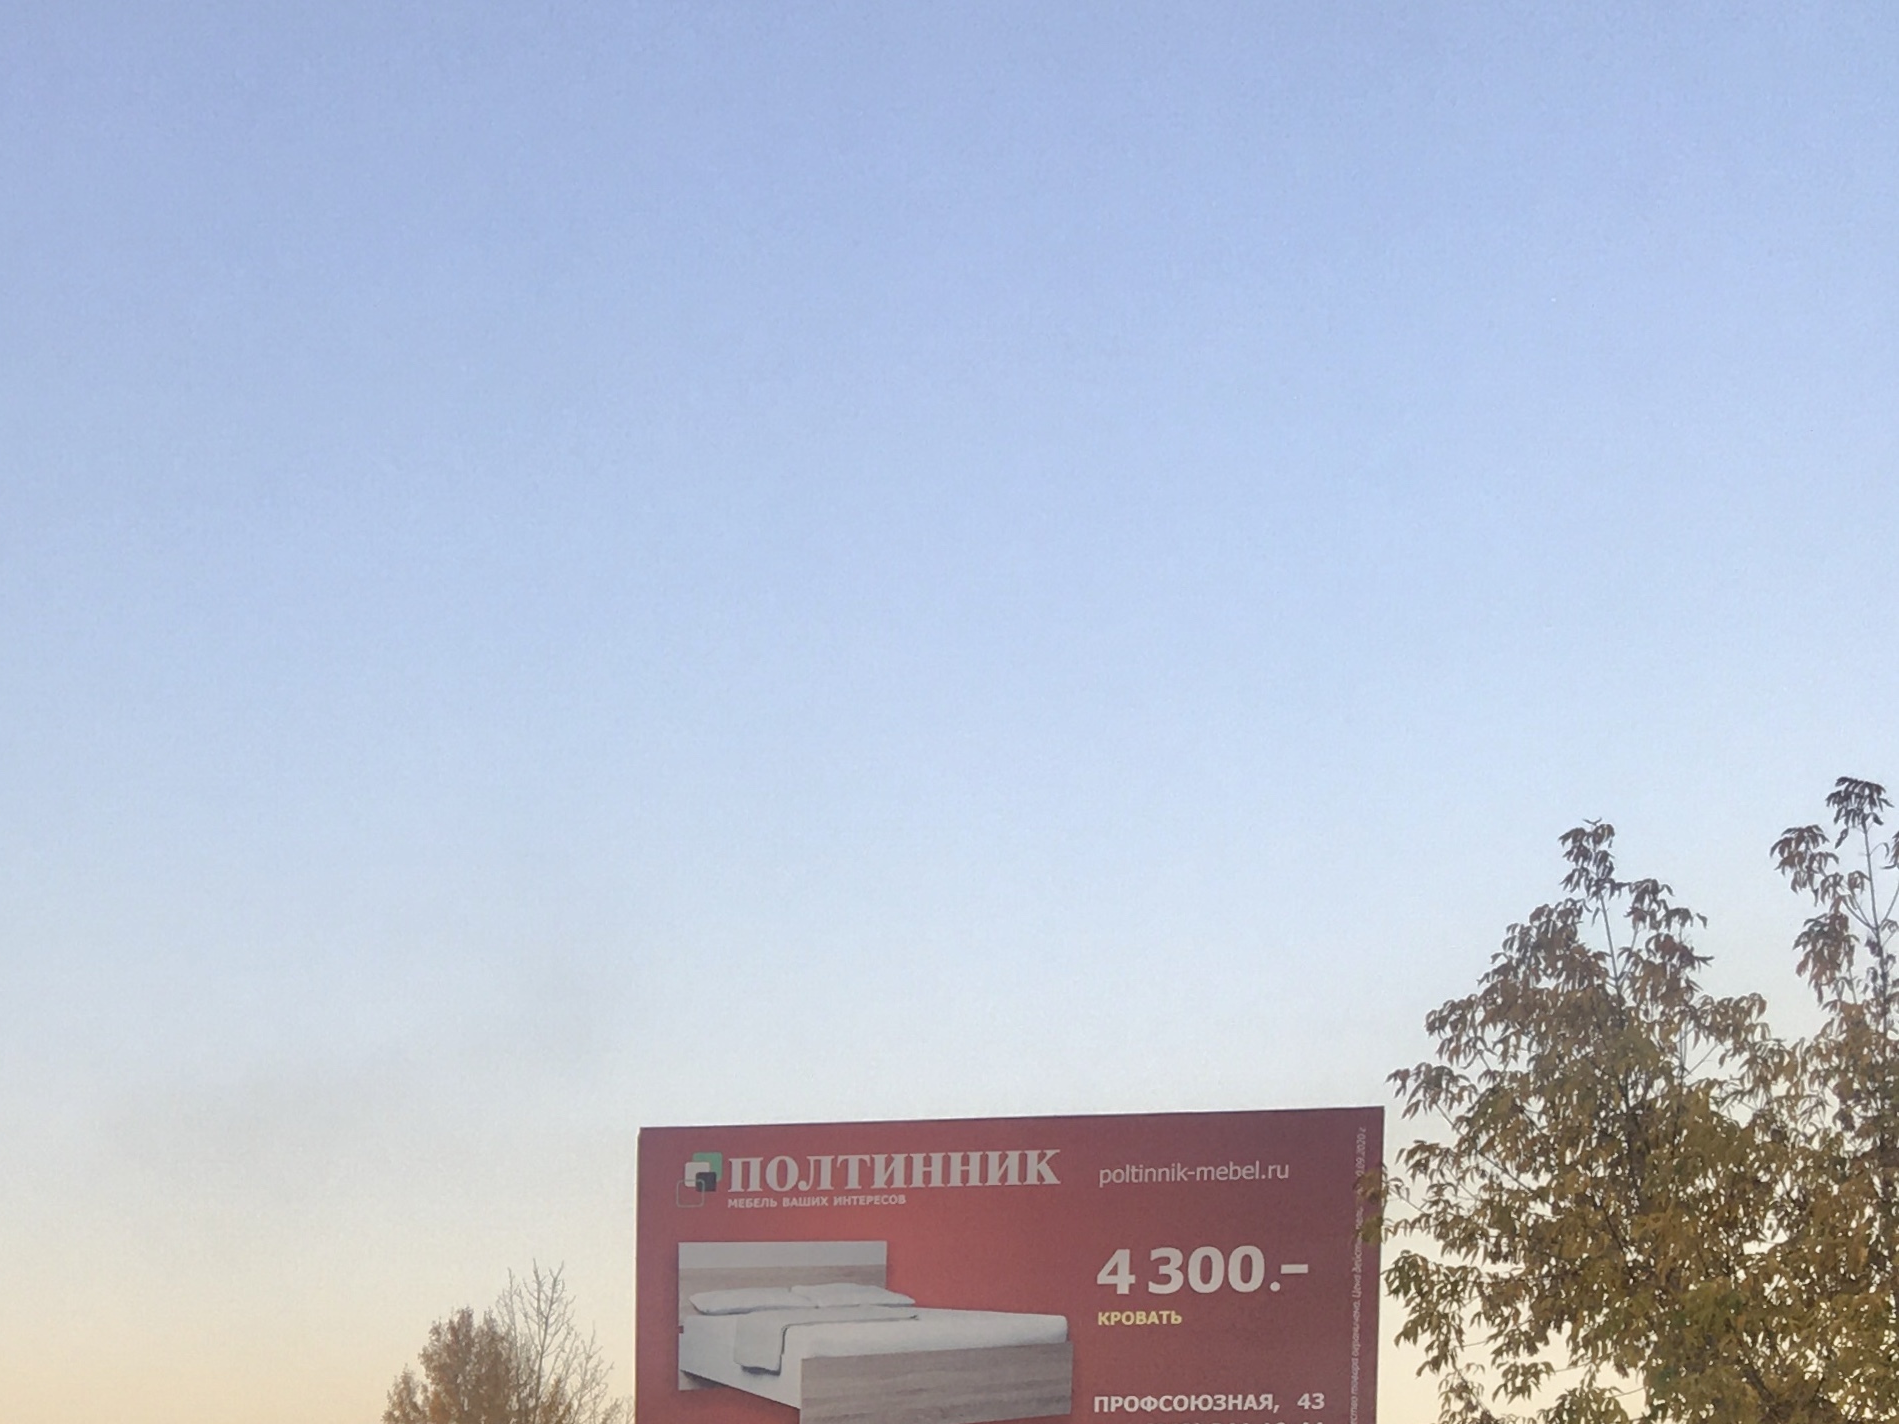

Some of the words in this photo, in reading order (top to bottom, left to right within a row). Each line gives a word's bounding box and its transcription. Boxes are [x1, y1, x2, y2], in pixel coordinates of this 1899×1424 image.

[727, 1148, 1062, 1193] ПОЛТИННИК
[1099, 1160, 1290, 1188] poltinnik-mebel.ru
[727, 1197, 778, 1209] МЕБЕЛЬ
[782, 1195, 829, 1208] ВАШИХ
[833, 1194, 907, 1207] ИНТЕРЕСОВ
[1097, 1311, 1183, 1325] КРОВАТЬ
[1093, 1393, 1280, 1413] ПРОФСОЮЗНАЯ,
[1297, 1393, 1325, 1410] 43
